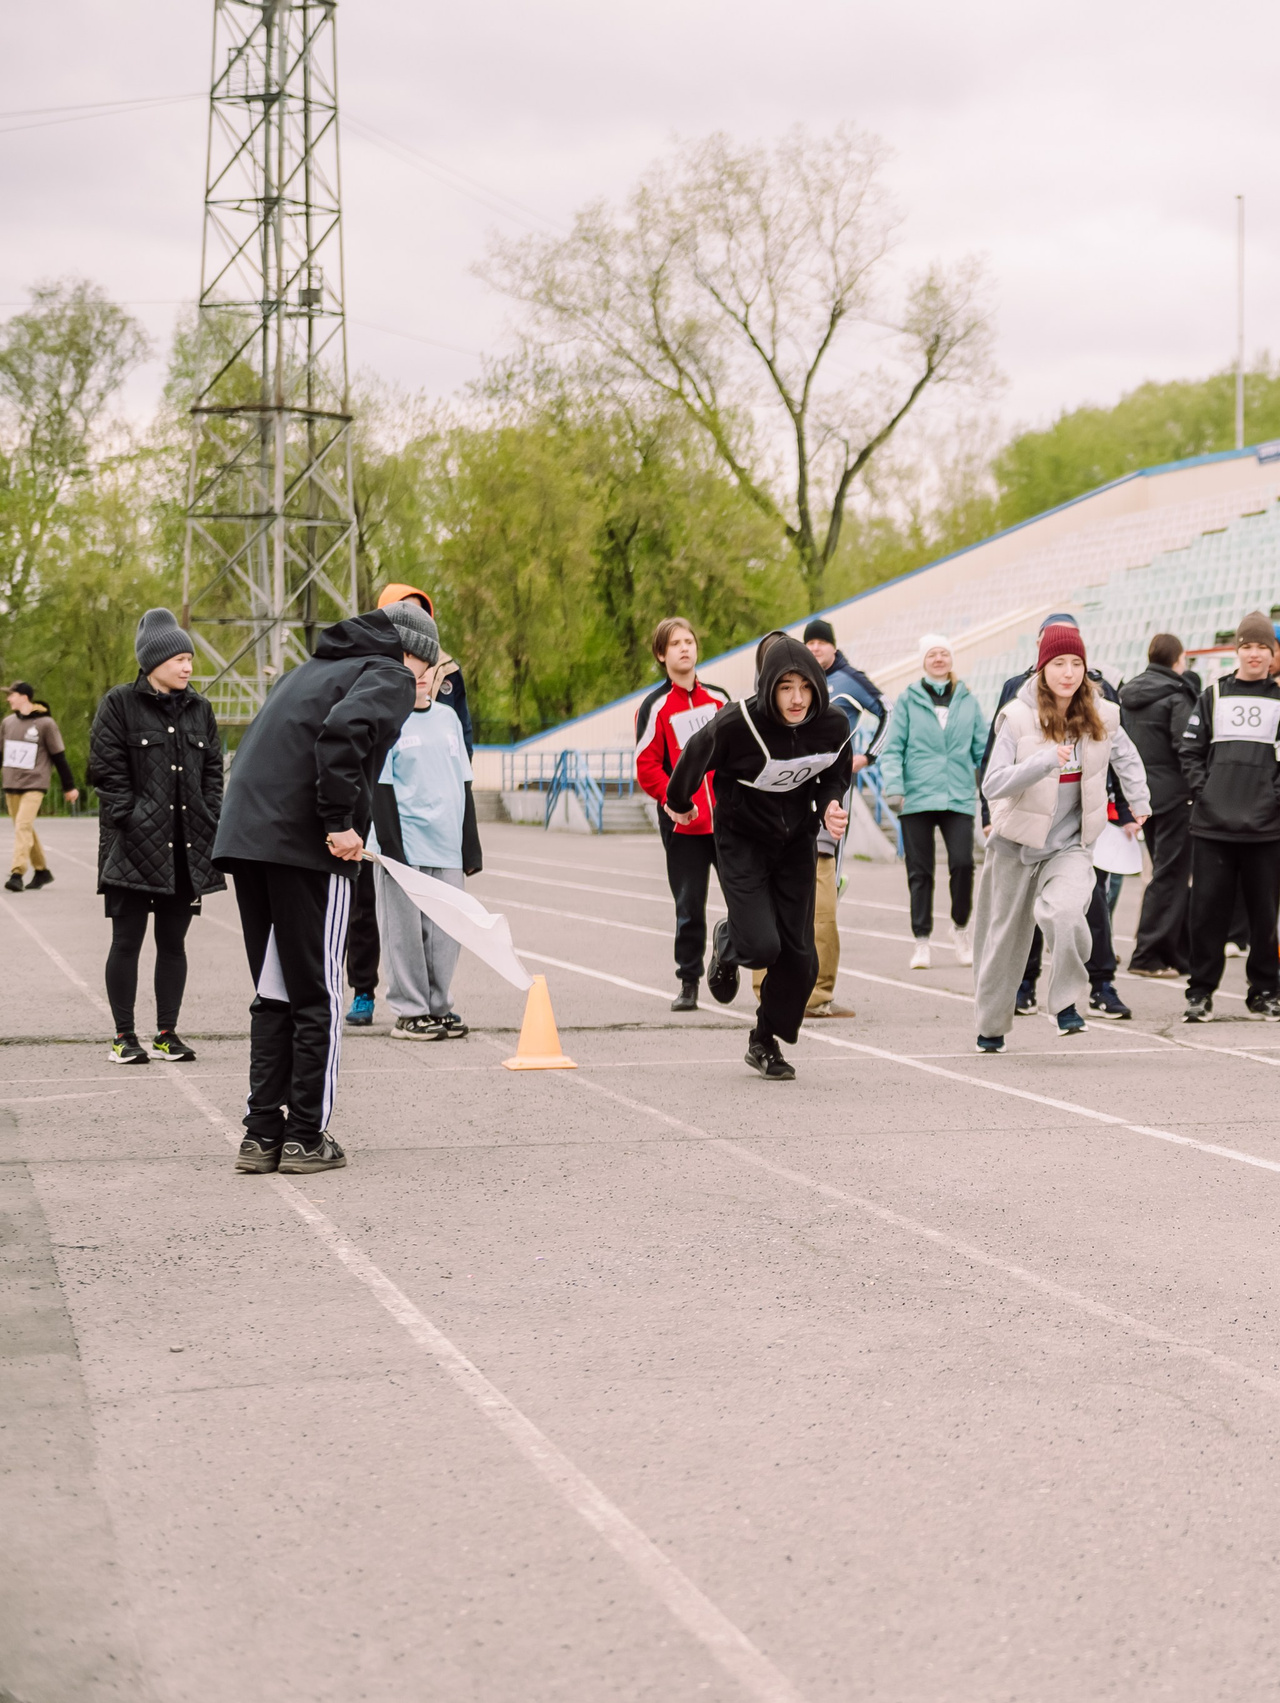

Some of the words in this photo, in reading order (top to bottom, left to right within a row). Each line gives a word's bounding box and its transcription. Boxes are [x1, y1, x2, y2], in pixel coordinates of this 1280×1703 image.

[1231, 705, 1261, 727] 38
[9, 750, 28, 764] 47
[771, 767, 812, 786] 20
